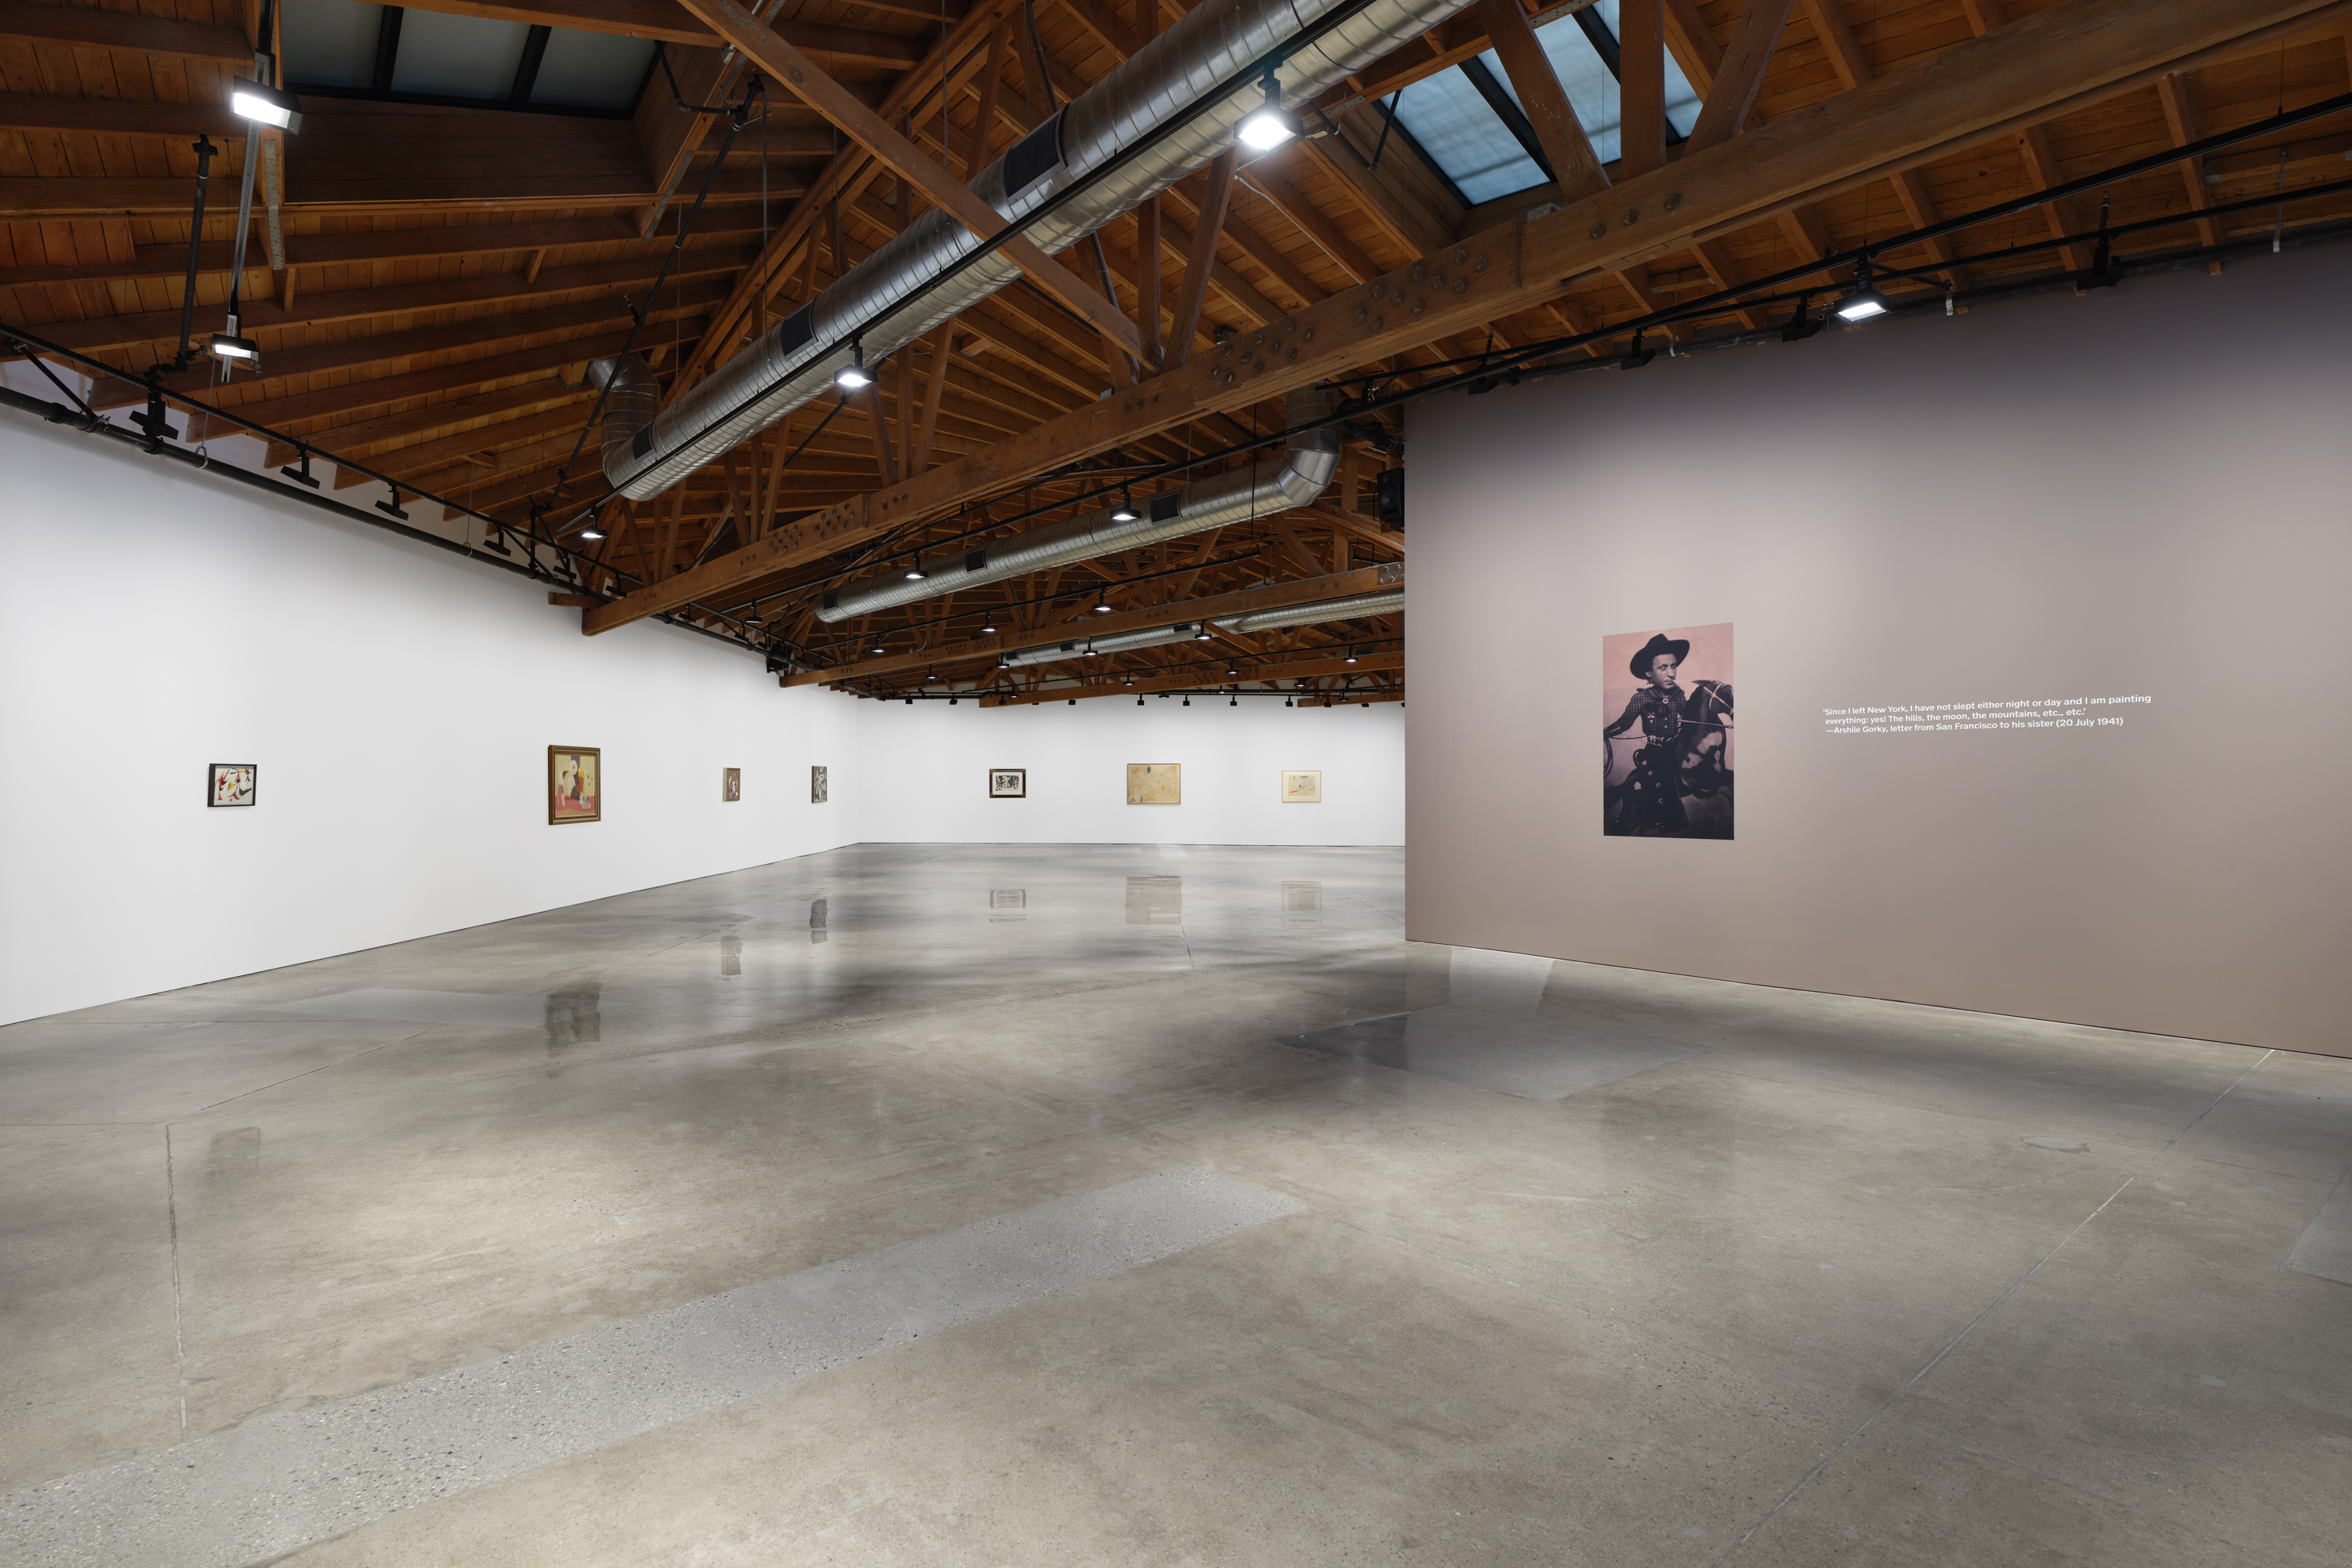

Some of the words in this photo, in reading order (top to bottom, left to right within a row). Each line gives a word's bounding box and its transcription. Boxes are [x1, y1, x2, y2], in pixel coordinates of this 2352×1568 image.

[1888, 705, 1907, 713] York,
[1954, 702, 1975, 711] slept
[1977, 701, 2004, 710] either
[2006, 699, 2030, 710] night
[2045, 699, 2061, 707] day
[2064, 697, 2082, 706] and
[2109, 694, 2151, 705] painting
[1826, 717, 1868, 725] everything:
[1871, 715, 1886, 724] yes!
[1889, 714, 1903, 723] The
[1906, 713, 1924, 722] hills,
[1944, 712, 1969, 720] moon,
[1989, 710, 2040, 719] mountains,
[1863, 725, 1888, 734] Gorky,
[1955, 721, 1998, 730] Francisco
[2056, 718, 2073, 728] (20
[2075, 718, 2094, 728] July
[2097, 717, 2123, 727] 1941)
